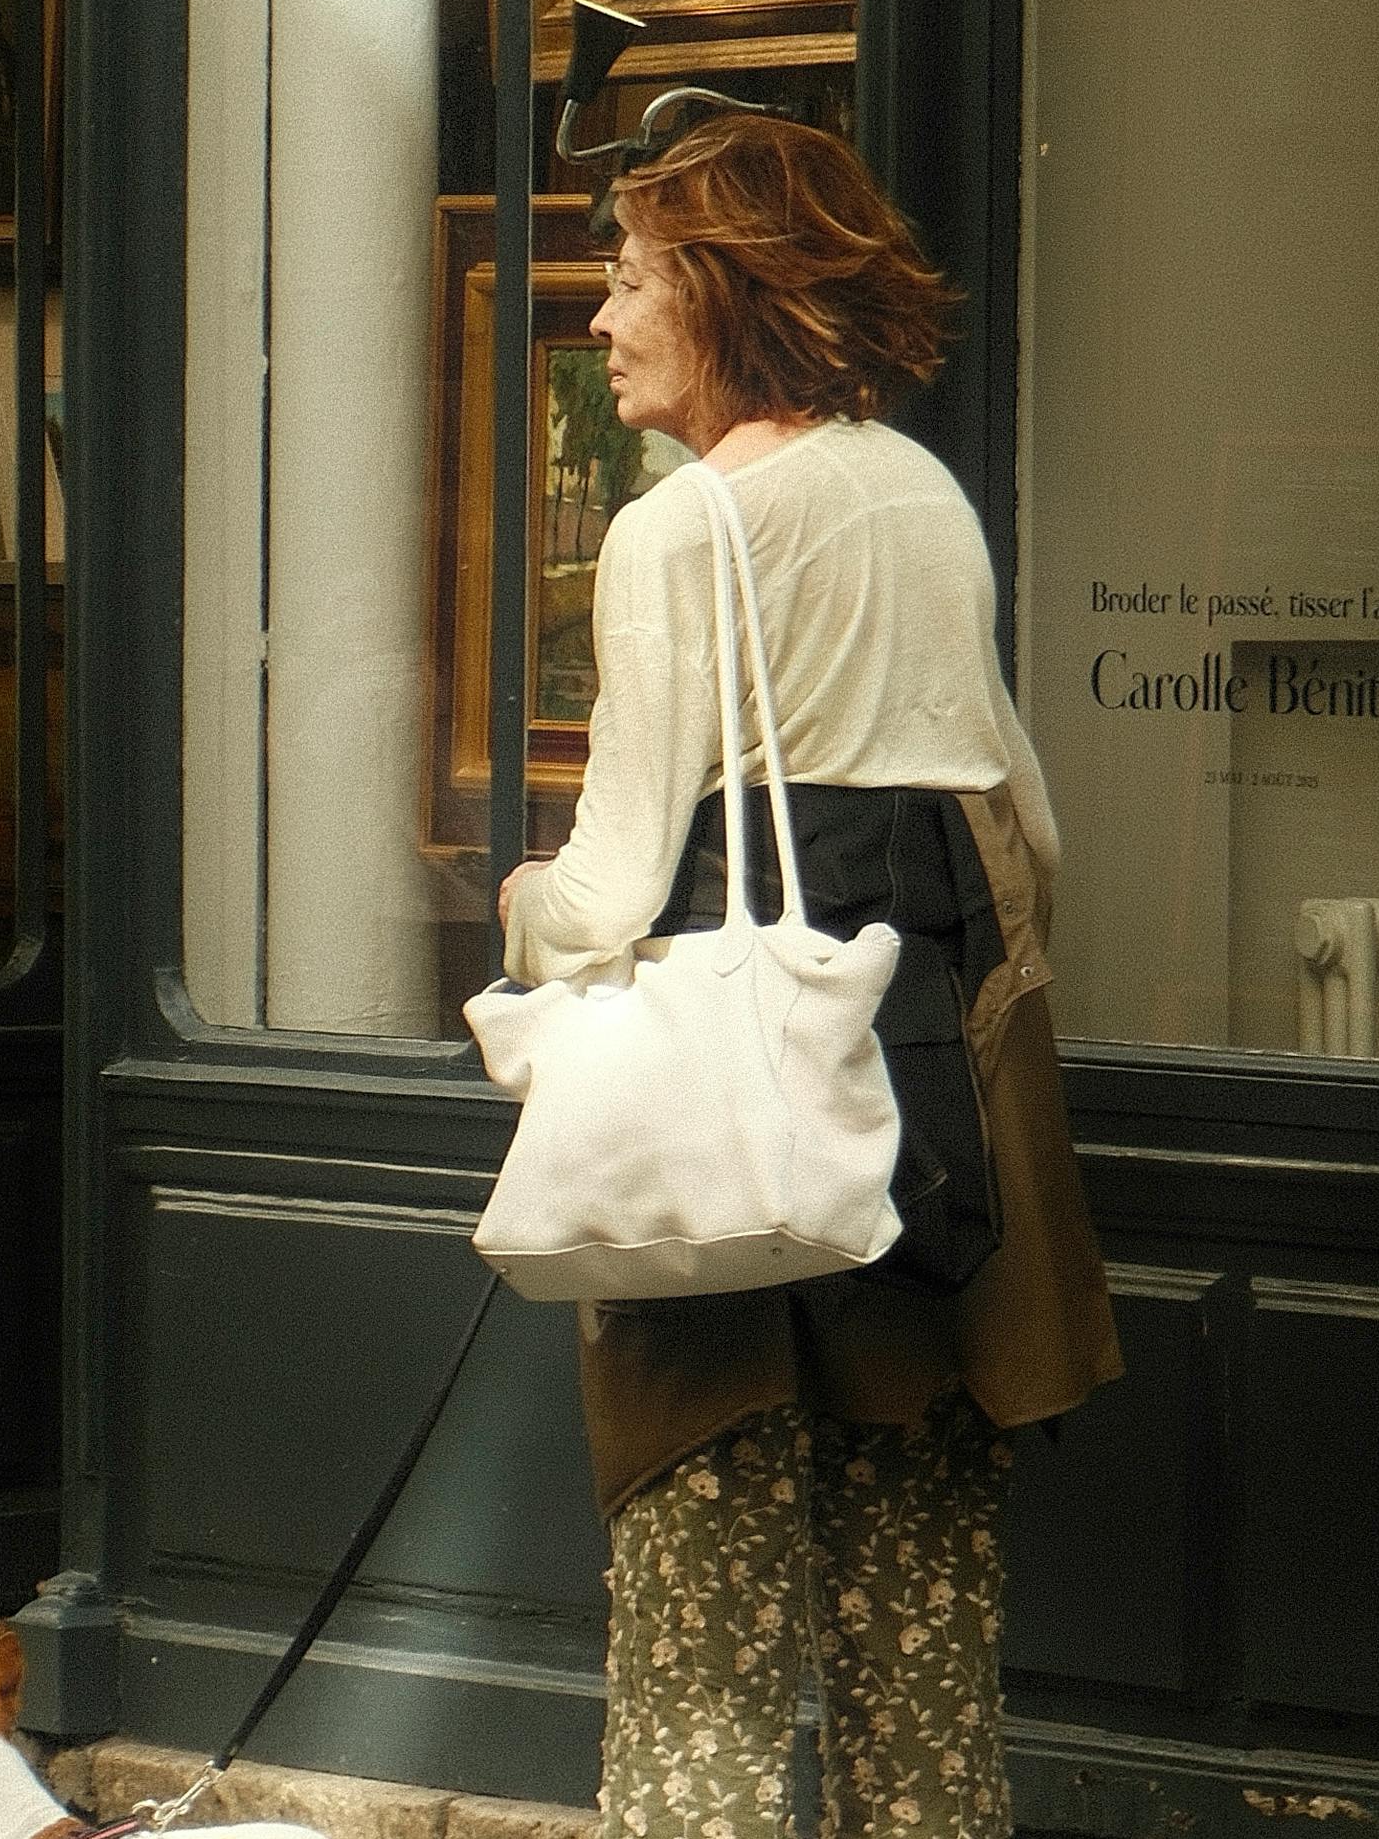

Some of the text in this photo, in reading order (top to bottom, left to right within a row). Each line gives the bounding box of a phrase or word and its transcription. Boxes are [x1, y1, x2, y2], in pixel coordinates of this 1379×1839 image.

[1091, 580, 1171, 614] Broder
[1180, 582, 1198, 615] le
[1289, 590, 1353, 619] tisser
[1089, 649, 1248, 713] Carolle
